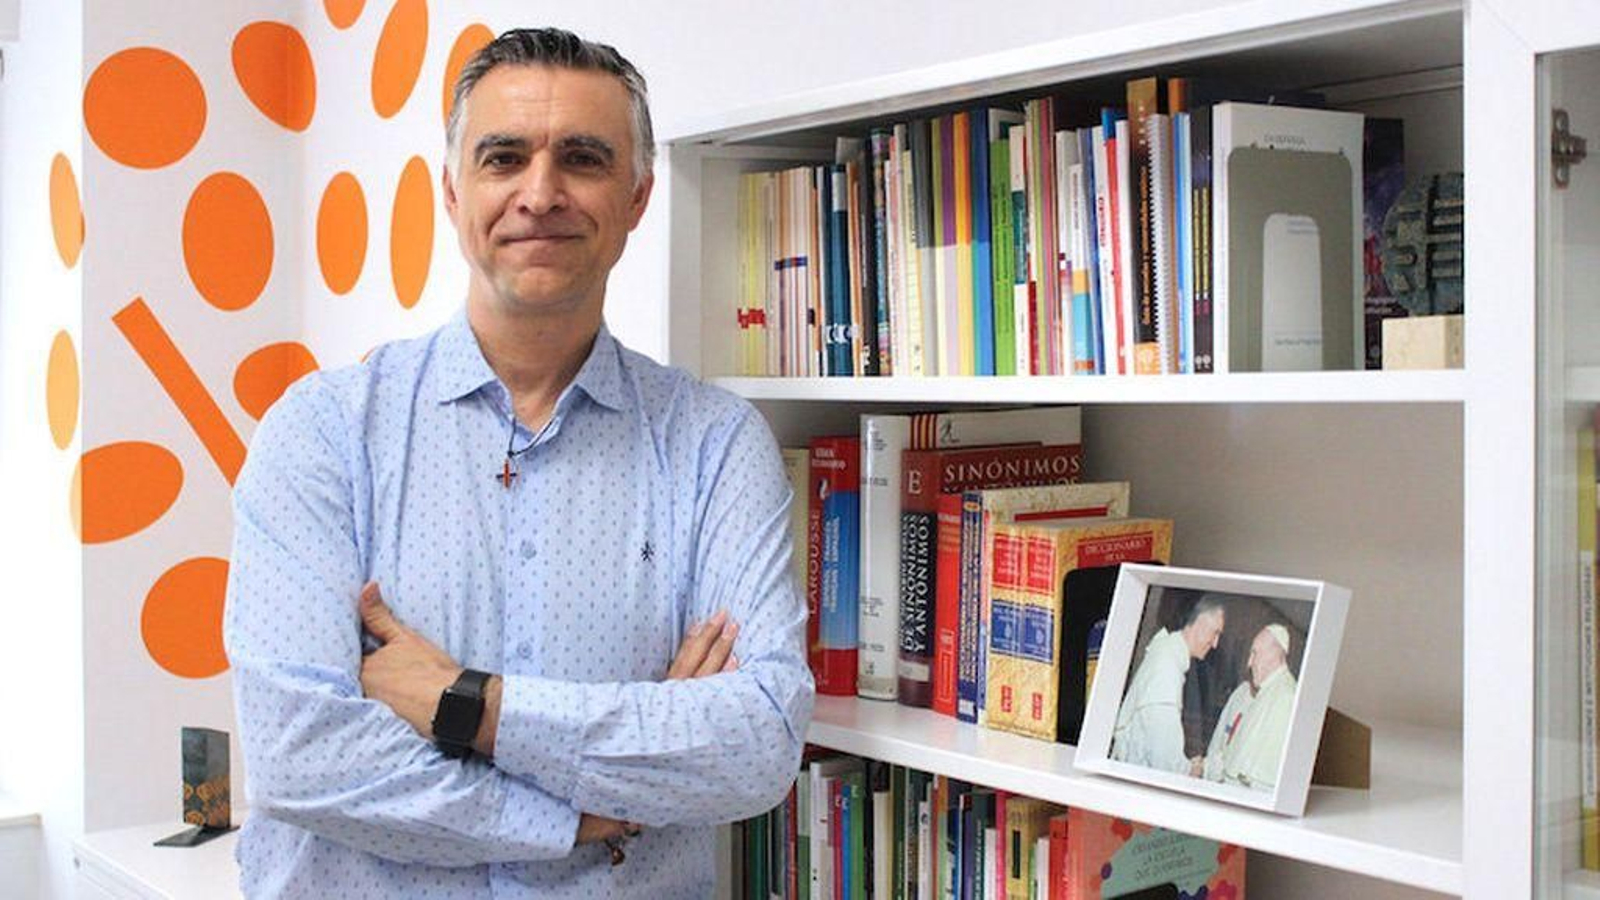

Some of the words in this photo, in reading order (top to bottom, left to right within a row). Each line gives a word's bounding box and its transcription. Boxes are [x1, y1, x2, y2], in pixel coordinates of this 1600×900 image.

[944, 455, 1081, 483] SINÓNIMOS
[908, 470, 922, 494] E
[1085, 539, 1147, 554] DICCIONARIO
[808, 509, 821, 615] LAROUSSE
[904, 627, 915, 651] DE
[913, 641, 926, 652] Y
